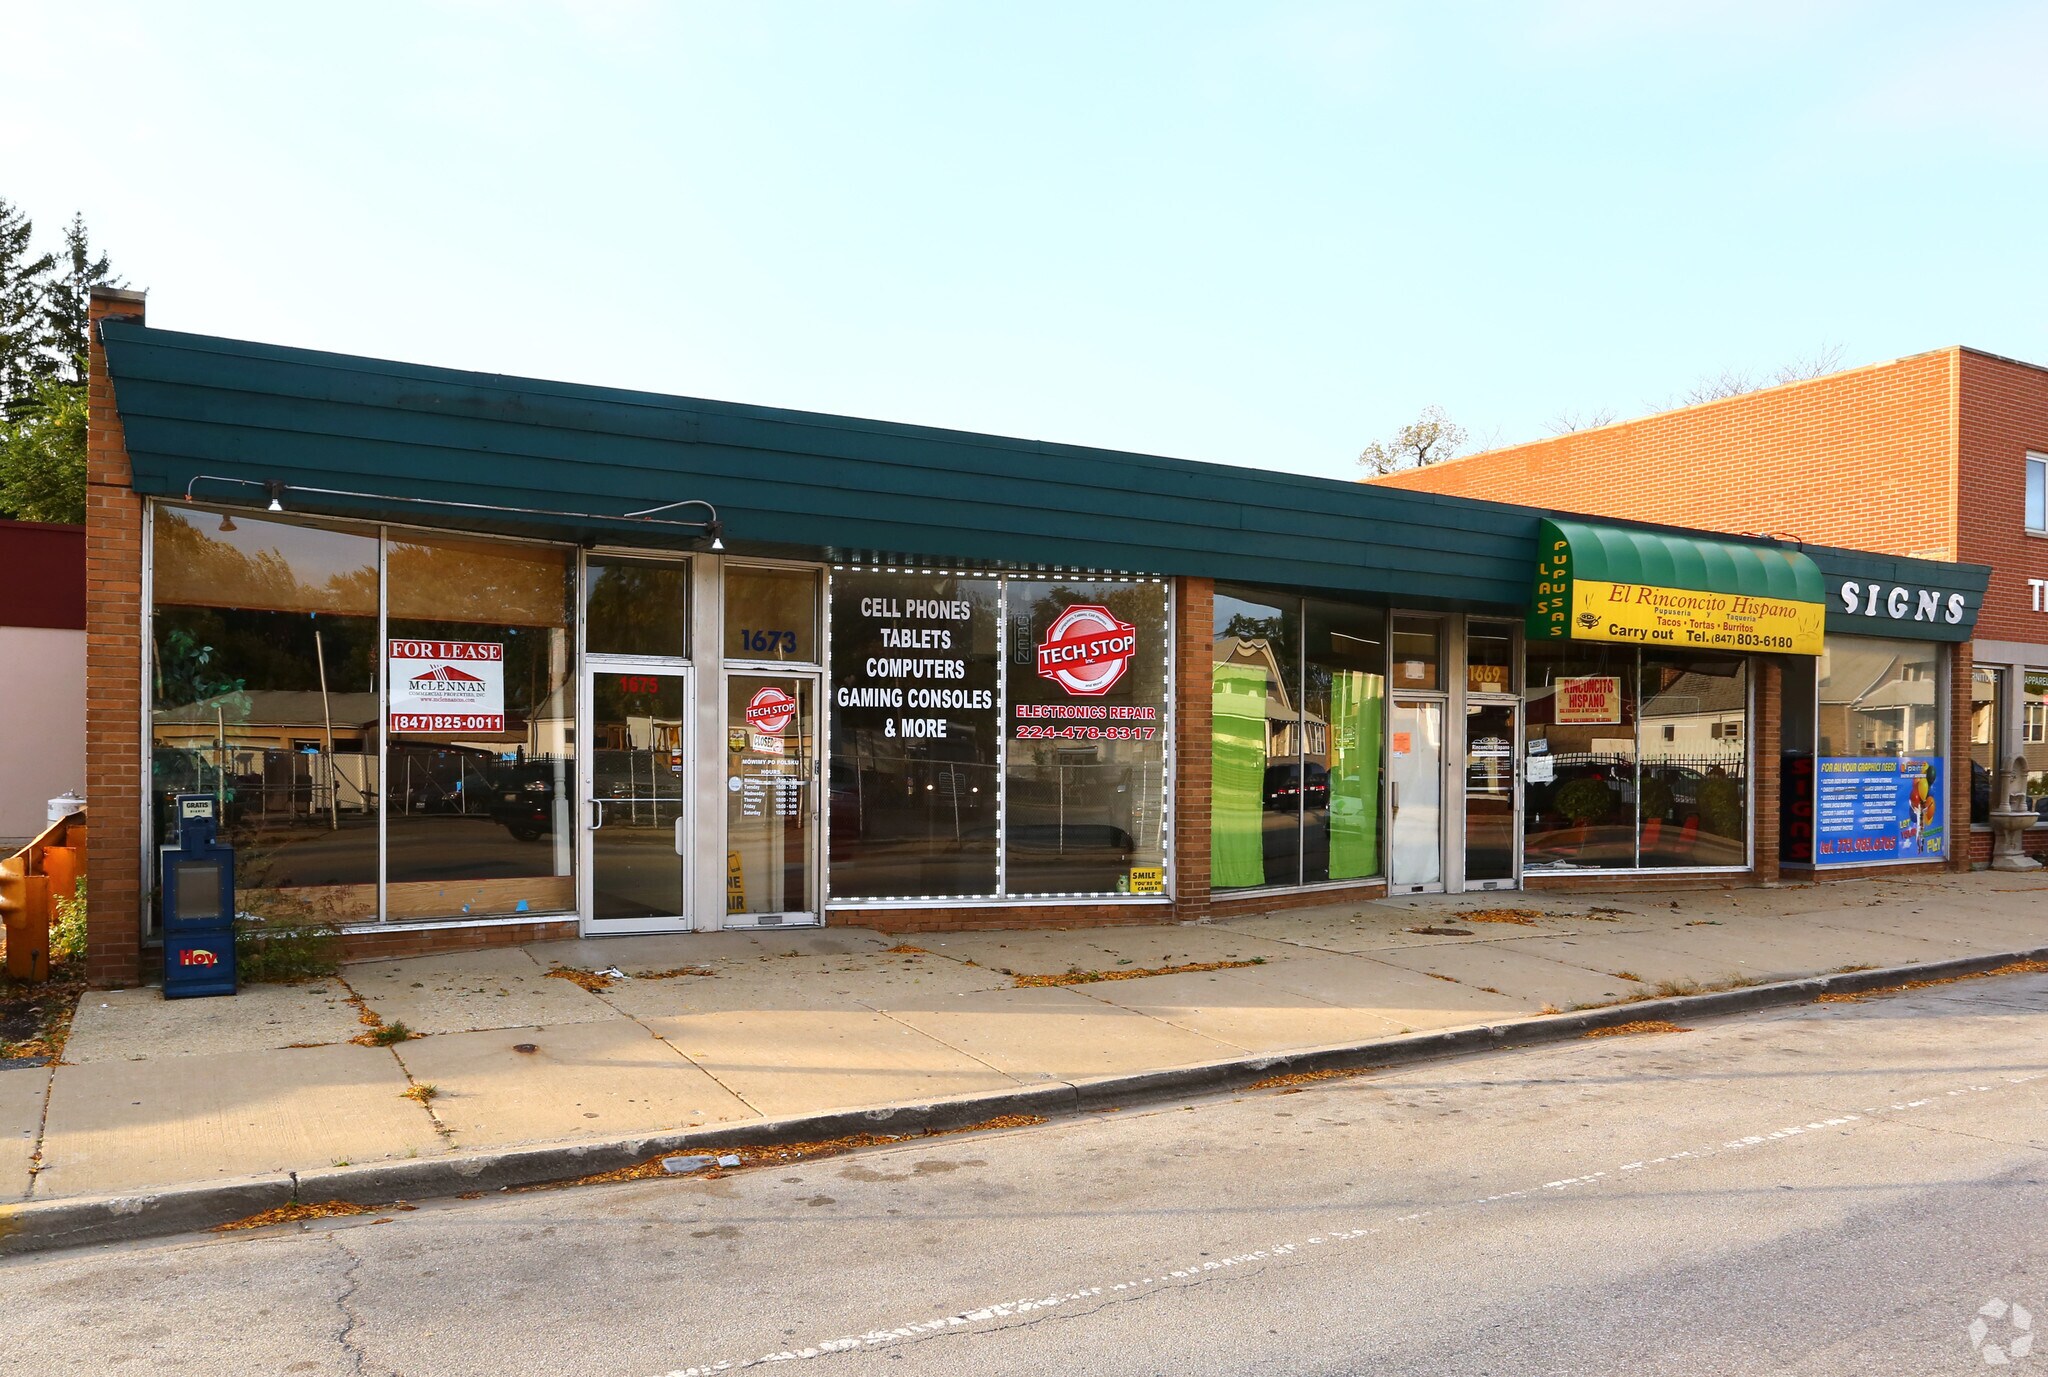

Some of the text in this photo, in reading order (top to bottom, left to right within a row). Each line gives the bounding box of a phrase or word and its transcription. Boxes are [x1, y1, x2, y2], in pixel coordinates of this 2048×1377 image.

[1537, 563, 1551, 614] LAS
[1551, 541, 1567, 636] PUPUSAS
[861, 598, 970, 620] CELL PHONES
[1608, 584, 1796, 619] El Rinconcito Hispano
[1841, 581, 1965, 624] SIGNS
[1654, 607, 1691, 617] Pupuseria
[1609, 623, 1647, 640] Carry
[1652, 628, 1674, 640] out
[1686, 630, 1709, 642] Tel.
[1657, 616, 1753, 632] Tacos Tortas Burritos
[742, 630, 797, 653] 1673
[881, 629, 950, 649] TABLETS
[391, 642, 501, 660] FOR LEASE
[1040, 636, 1134, 665] TECH STOP
[866, 658, 965, 679] COMPUTERS
[1470, 665, 1500, 682] 1669
[409, 681, 486, 692] McLENNAN
[620, 677, 659, 693] 1675
[1564, 679, 1613, 694] RINCONCITO
[838, 688, 992, 709] GAMING CONSOLES
[1569, 694, 1605, 708] HISPANO
[747, 703, 795, 717] TECH STOP
[1016, 705, 1156, 719] ELECTRONICS REPAIR
[395, 716, 501, 731] (847)825-0011
[885, 718, 946, 737] & MORE
[1016, 726, 1156, 739] 224-478-8317
[1132, 872, 1156, 880] SMILE
[179, 950, 218, 968] Hoy
